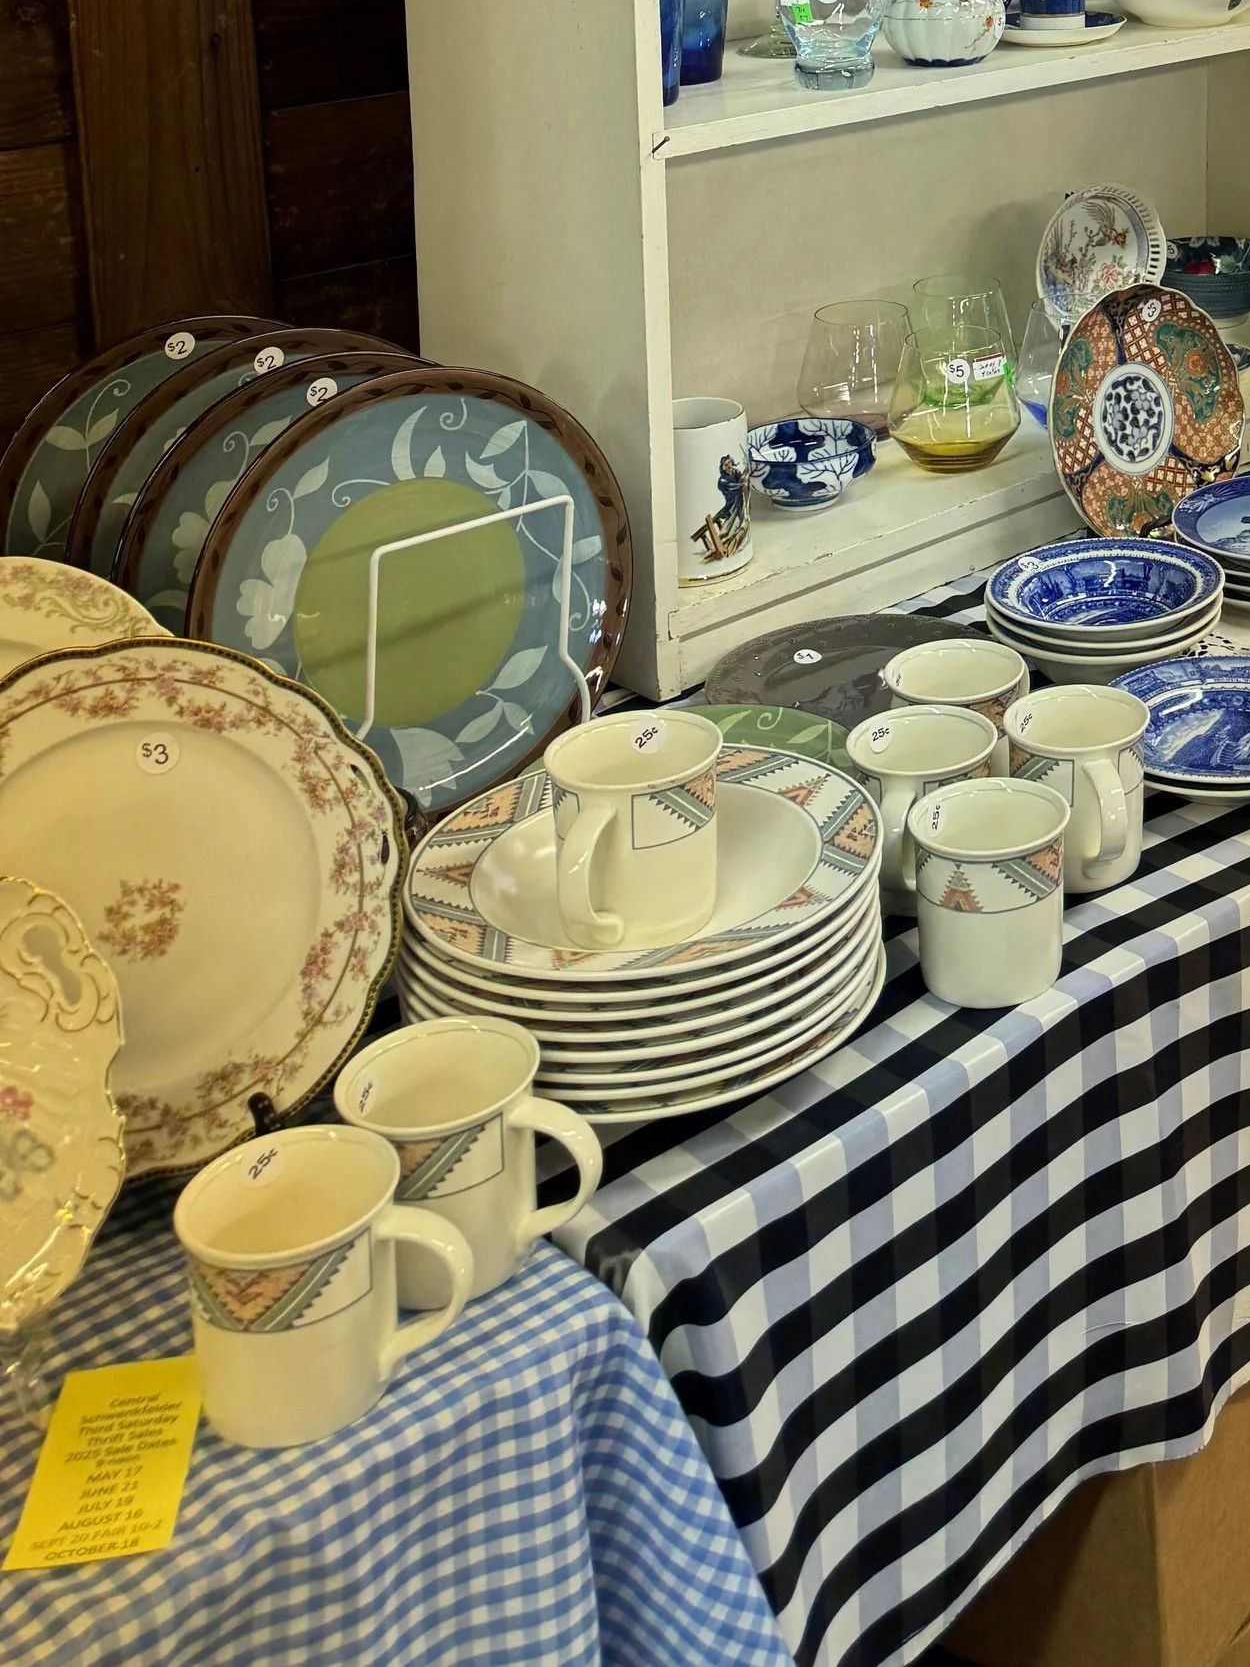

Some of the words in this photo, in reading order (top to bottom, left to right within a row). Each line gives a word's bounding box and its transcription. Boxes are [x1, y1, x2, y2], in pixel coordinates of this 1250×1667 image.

[167, 340, 188, 355] $2
[256, 354, 276, 370] $2
[949, 363, 965, 378] $5
[310, 385, 329, 403] $2
[797, 651, 813, 662] $1
[871, 727, 890, 742] 25¢
[1019, 713, 1033, 735] 25¢
[634, 726, 659, 750] 25¢
[141, 742, 169, 765] $3
[931, 803, 941, 831] 25¢
[358, 1080, 374, 1114] 25¢
[248, 1147, 279, 1180] 25¢
[109, 1393, 160, 1408] Central
[80, 1401, 183, 1424] Schwenkfelder
[79, 1422, 114, 1435] Third
[115, 1413, 179, 1431] Saturday
[87, 1435, 125, 1447] Thrift
[127, 1428, 163, 1439] Sales
[65, 1450, 101, 1463] 2025
[104, 1444, 131, 1456] Sale
[136, 1436, 178, 1451] Dates
[86, 1470, 122, 1484] MAY
[123, 1465, 143, 1477] 17
[79, 1486, 117, 1500] JUNE
[120, 1480, 139, 1493] 21
[76, 1501, 113, 1515] JULY
[115, 1494, 135, 1507] 19
[57, 1512, 122, 1533] AUGUST
[124, 1508, 144, 1520] 16
[69, 1533, 90, 1544] 20
[43, 1543, 118, 1562] OCTOBER
[119, 1537, 140, 1549] 18
